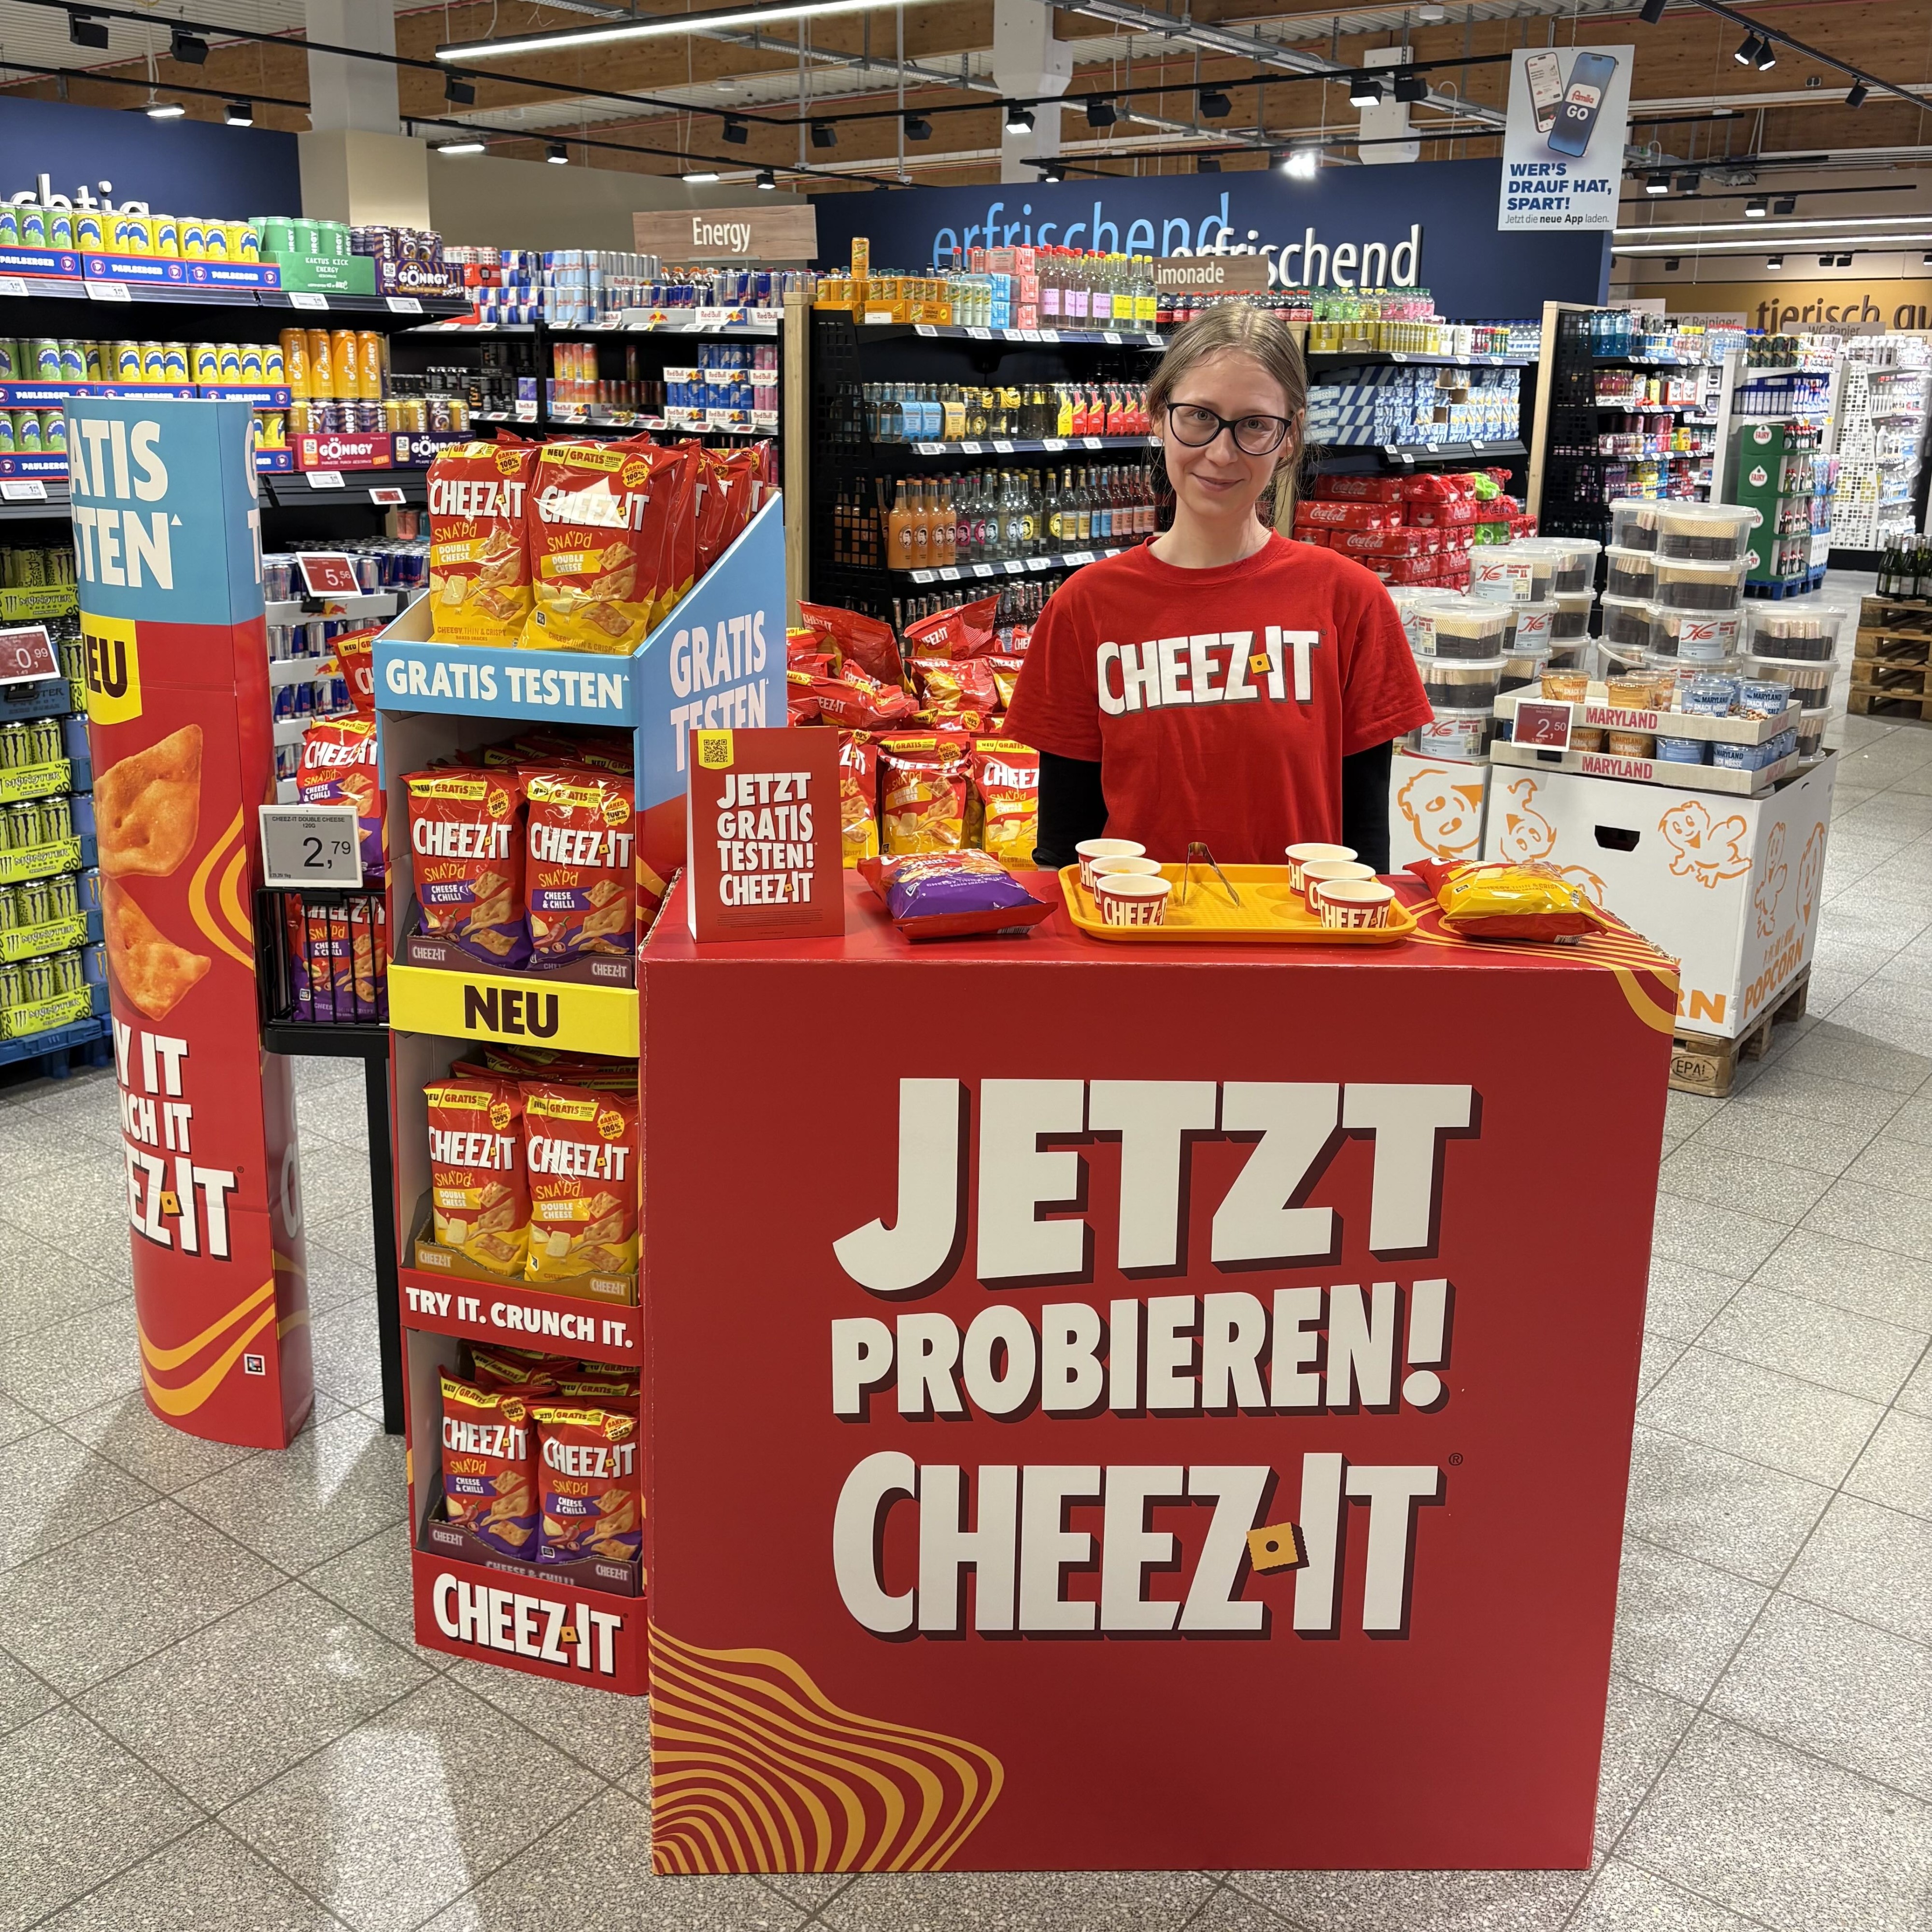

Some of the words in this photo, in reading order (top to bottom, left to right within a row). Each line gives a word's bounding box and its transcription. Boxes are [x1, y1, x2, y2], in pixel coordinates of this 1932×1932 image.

[1567, 106, 1589, 120] GO
[1510, 163, 1567, 176] WER'S
[1508, 180, 1568, 193] DRAUF
[1573, 179, 1612, 195] HAT,
[1506, 197, 1570, 210] SPART!
[1505, 215, 1524, 224] Jetzt
[1526, 214, 1538, 223] die
[1564, 214, 1583, 225] App
[1585, 214, 1609, 223] laden.
[692, 217, 751, 252] Energy
[547, 449, 564, 457] NEU
[570, 451, 605, 465] GRATIS
[438, 543, 470, 554] DOUBLE
[441, 552, 470, 563] CHEESE
[552, 554, 584, 566] DOUBLE
[555, 563, 582, 573] CHEESE
[669, 610, 767, 699] GRATIS
[83, 632, 128, 698] EU
[386, 658, 497, 701] GRATIS
[505, 666, 623, 710] TESTEN
[1701, 695, 1728, 704] MARYLAND
[1753, 692, 1782, 702] MARYLAND
[1747, 700, 1764, 709] SNACK
[1585, 707, 1658, 730] MARYLAND
[1716, 749, 1744, 760] MARYLAND
[1582, 755, 1653, 780] MARYLAND
[305, 784, 328, 795] CHEESE
[435, 783, 469, 794] GRATIS
[716, 772, 812, 809] JETZT
[717, 803, 813, 842] GRATIS
[431, 884, 458, 895] CHEESE
[438, 892, 461, 902] CHILLI
[544, 890, 571, 901] CHEESE
[549, 899, 575, 909] CHILLI
[1743, 932, 1805, 1021] POPCORN
[463, 984, 559, 1039] NEU
[141, 1031, 188, 1096] IT
[444, 1094, 477, 1105] GRATIS
[550, 1104, 580, 1115] GRATIS
[163, 1101, 192, 1153] IT
[832, 1077, 1473, 1292] JETZT
[439, 1190, 467, 1200] DOUBLE
[442, 1198, 467, 1208] CHEESE
[540, 1202, 573, 1212] DOUBLE
[543, 1209, 573, 1220] CHEESE
[405, 1285, 453, 1318] TRY
[457, 1295, 487, 1325] IT.
[490, 1302, 596, 1343] CRUNCH
[602, 1320, 634, 1349] IT.
[831, 1278, 1449, 1415] PROBIEREN!
[443, 1383, 456, 1393] NEU
[581, 1385, 611, 1394] GRATIS
[556, 1411, 587, 1420] GRATIS
[455, 1476, 481, 1487] CHEESE
[461, 1483, 484, 1494] CHILLI
[557, 1496, 583, 1508] CHEESE
[562, 1504, 587, 1515] CHILLI
